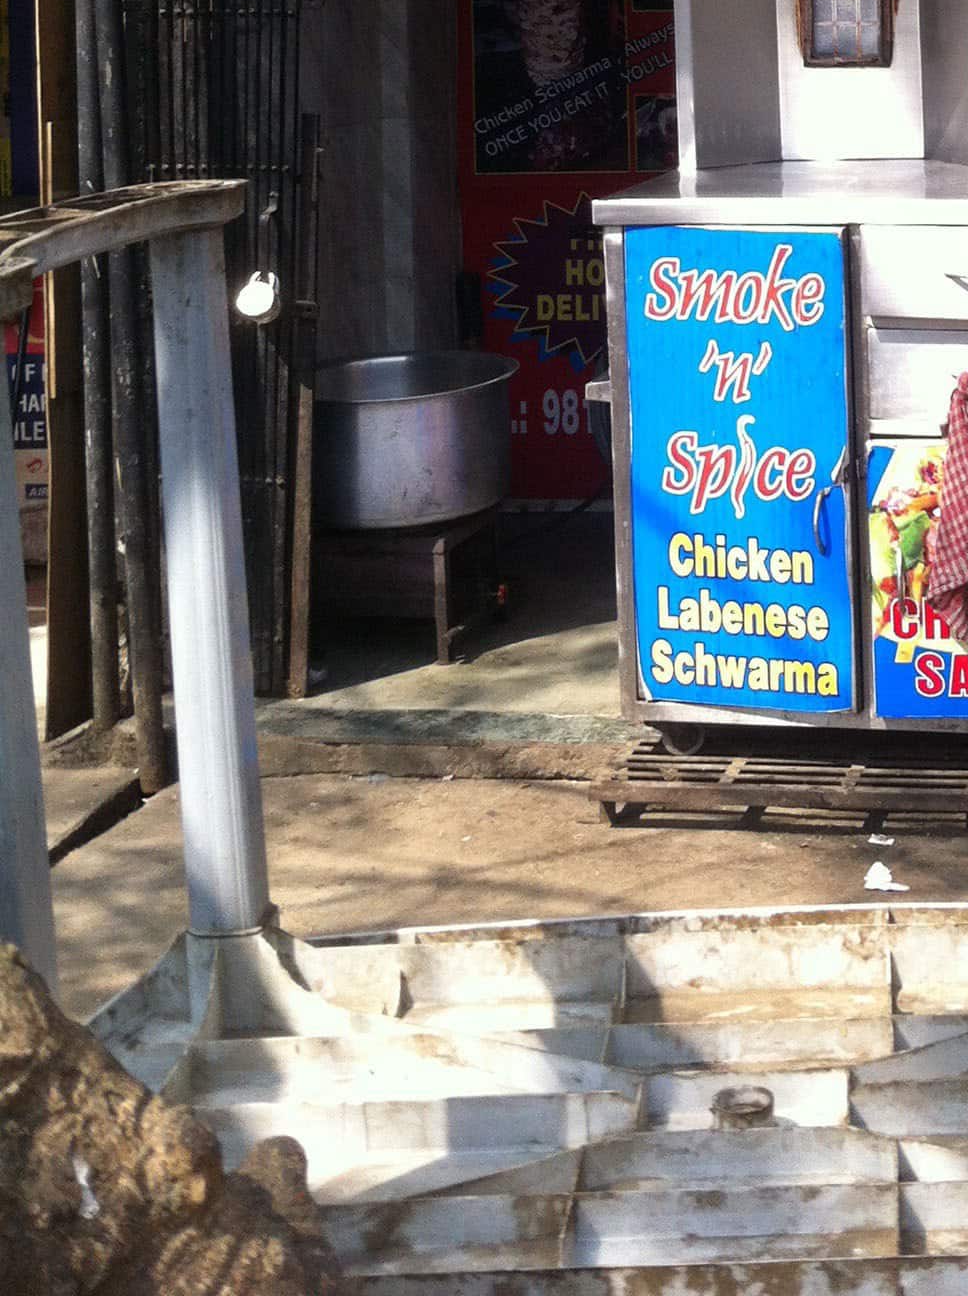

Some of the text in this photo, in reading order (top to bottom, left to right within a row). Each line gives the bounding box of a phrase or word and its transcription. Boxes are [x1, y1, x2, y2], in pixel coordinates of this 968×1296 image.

[474, 98, 534, 134] Chicken
[534, 57, 611, 104] Schwarma
[485, 125, 528, 156] ONCE
[528, 108, 562, 134] YOU
[563, 92, 595, 116] EAT
[645, 244, 825, 332] Smoke
[662, 415, 815, 519] Spice
[668, 531, 814, 585] Chicken
[657, 585, 830, 641] Labenese
[650, 638, 839, 696] Schwarma
